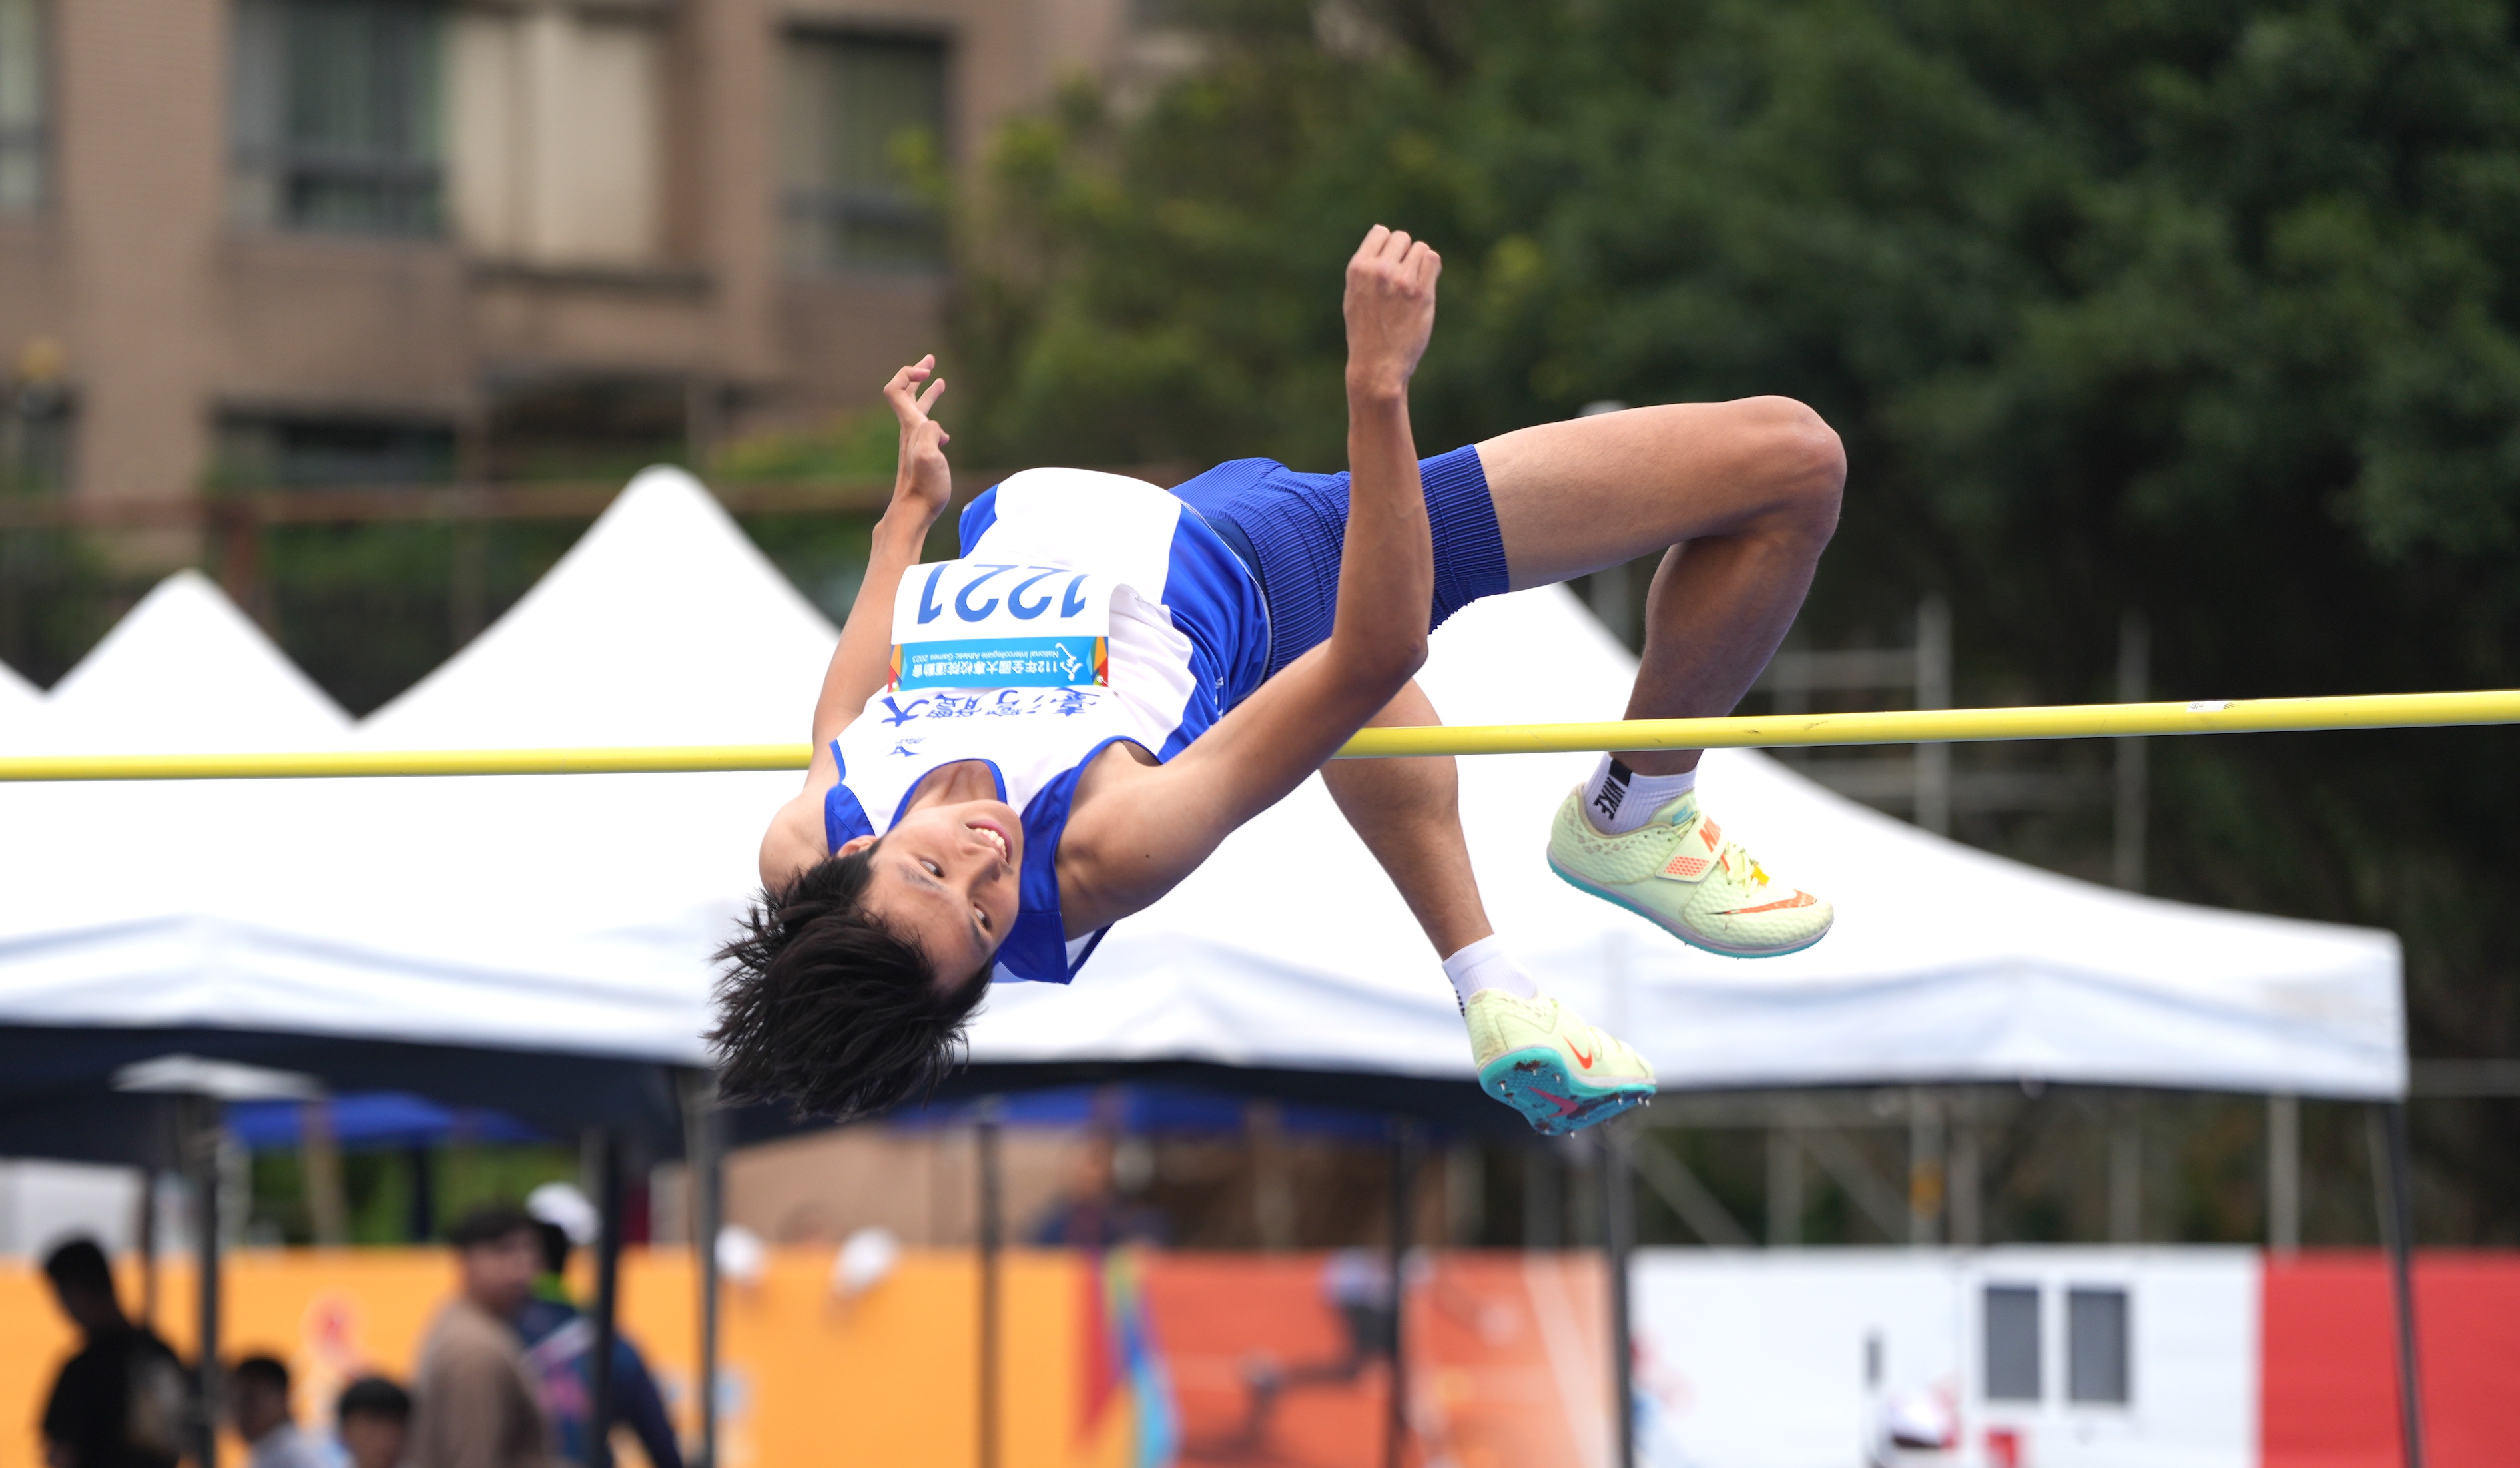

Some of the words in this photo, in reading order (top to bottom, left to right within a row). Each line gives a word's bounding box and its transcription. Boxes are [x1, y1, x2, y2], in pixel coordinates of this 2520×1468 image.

[917, 563, 1091, 624] 1221
[980, 650, 1028, 659] Intercollegiate
[1029, 650, 1058, 659] National
[1593, 777, 1626, 820] NIKE
